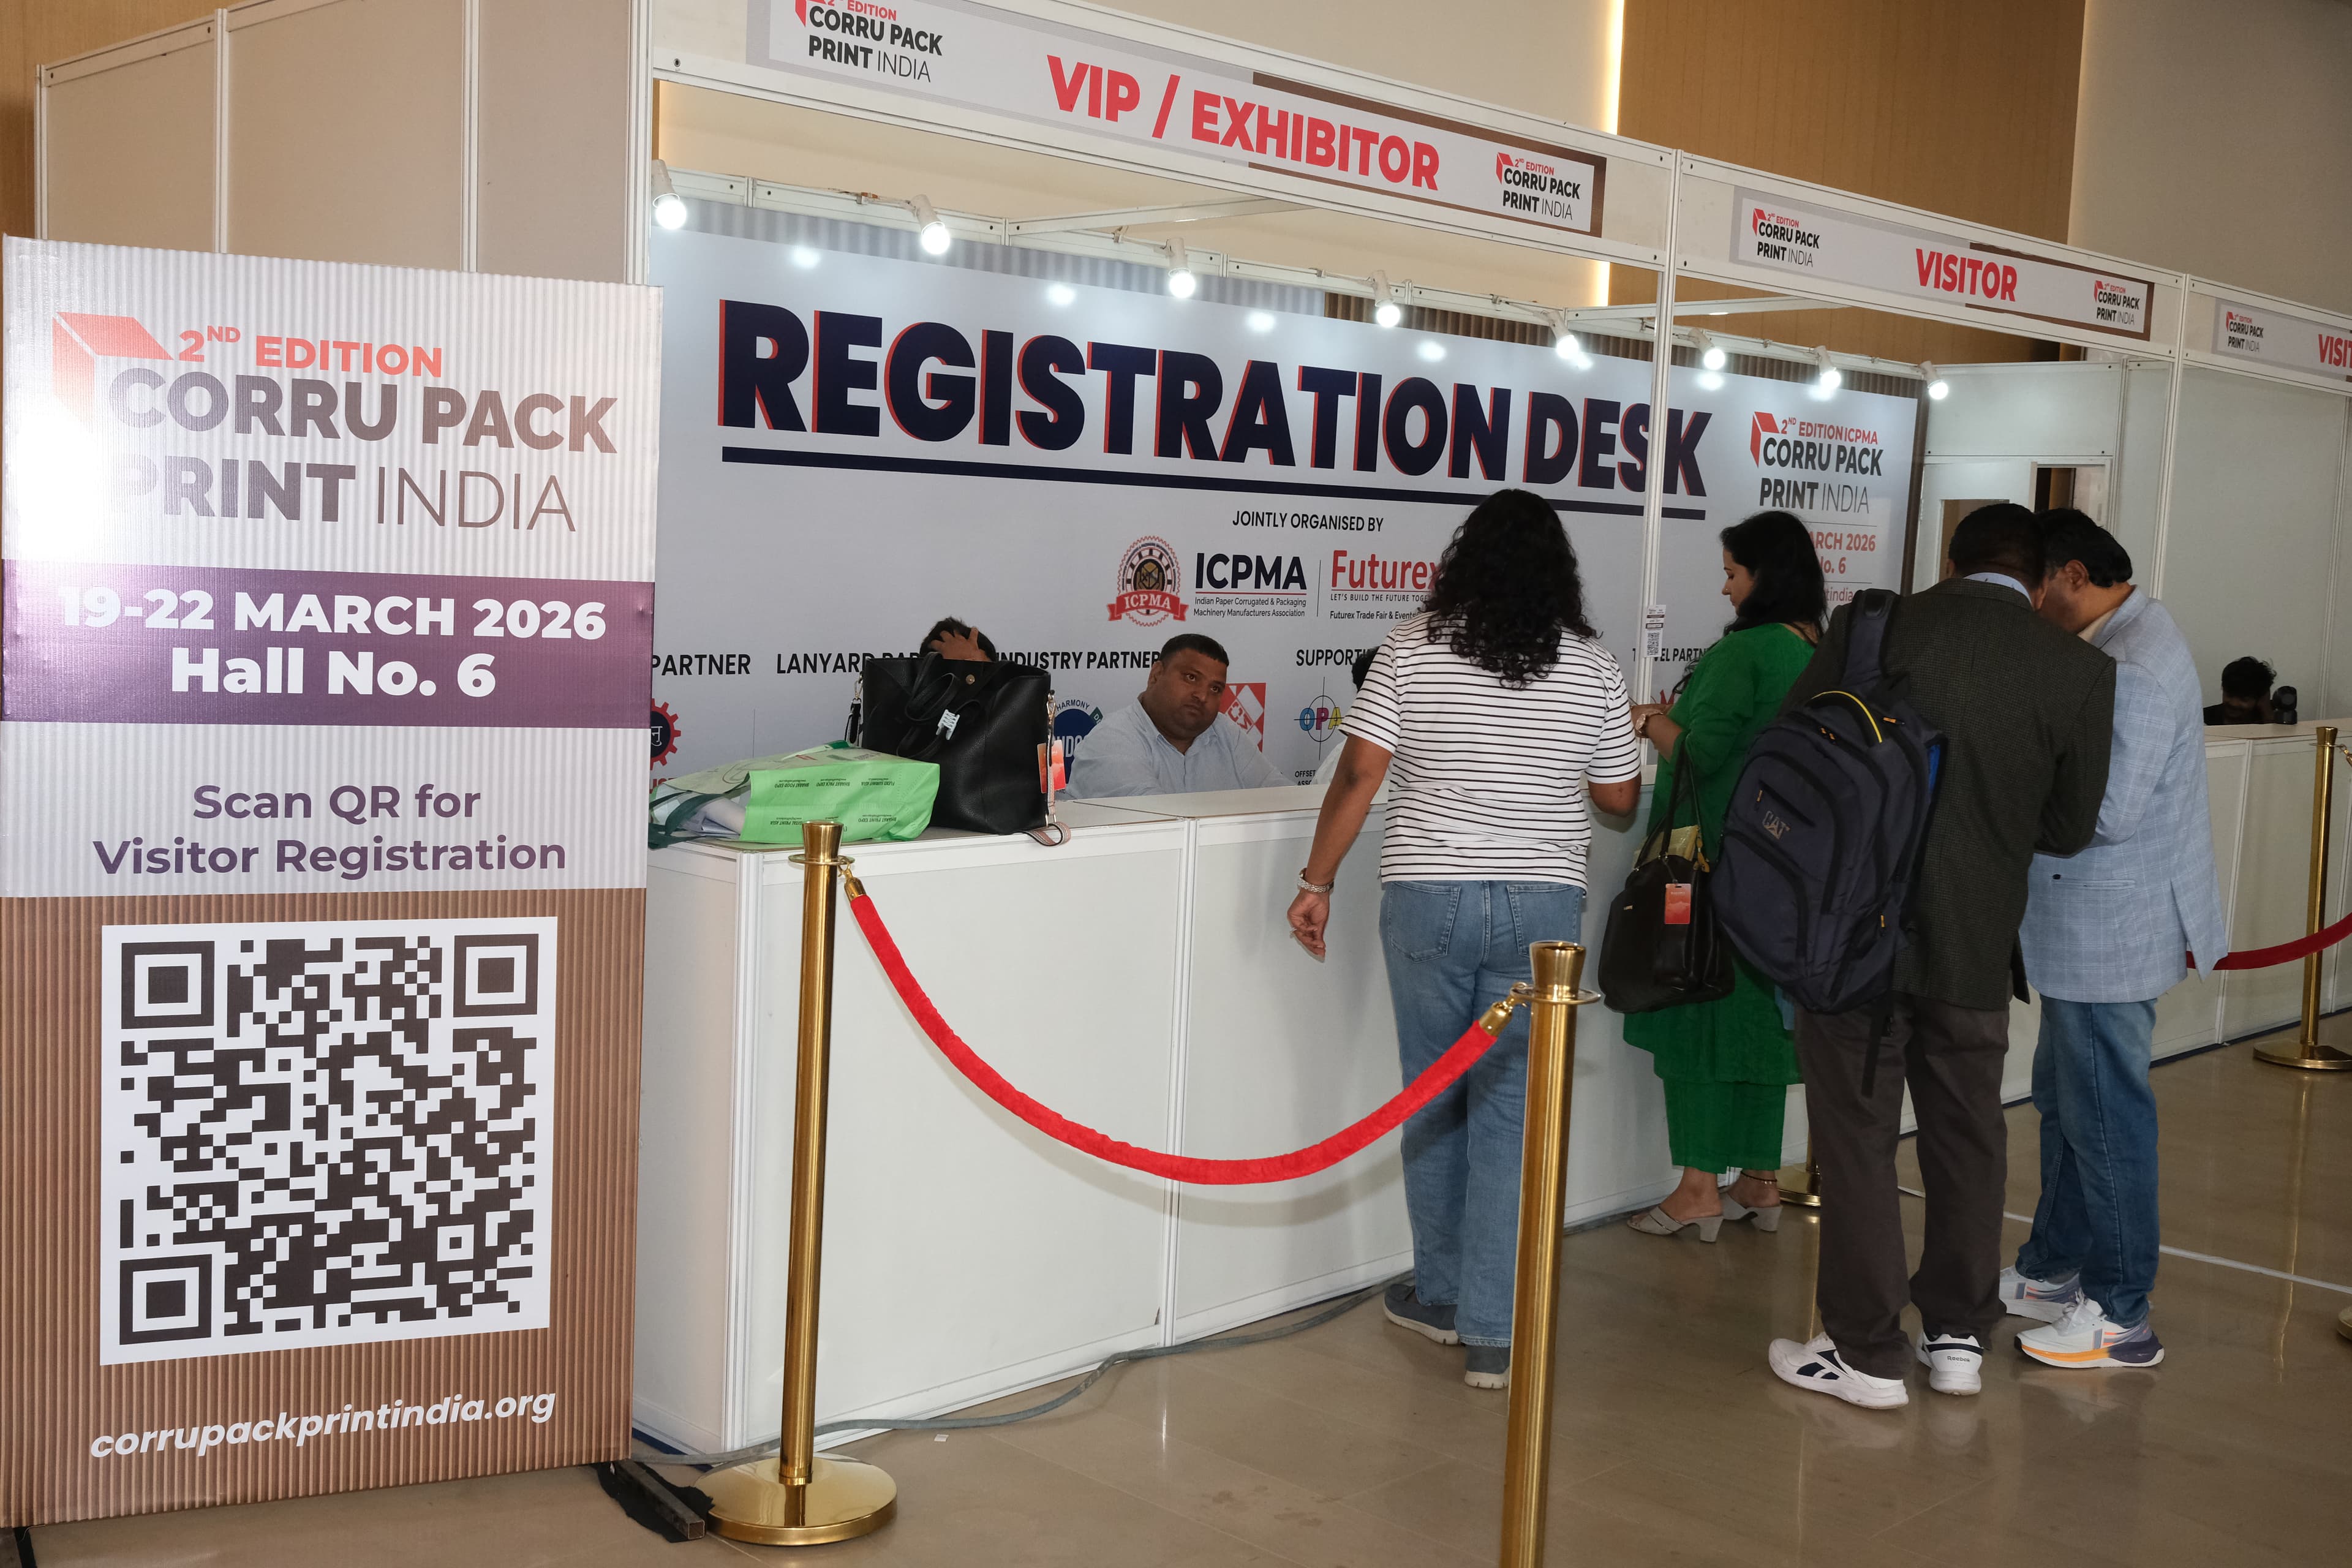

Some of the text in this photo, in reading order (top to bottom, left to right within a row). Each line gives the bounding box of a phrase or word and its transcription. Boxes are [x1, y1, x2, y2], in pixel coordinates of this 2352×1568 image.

[847, 0, 897, 21] EDITION
[809, 6, 943, 56] CORRU PACK
[809, 34, 931, 83] PRINT INDIA
[1047, 55, 1140, 122] VIP
[1191, 89, 1439, 190] EXHIBITOR
[1526, 162, 1555, 176] EDITION
[1504, 168, 1581, 200] CORRU PACK
[1503, 190, 1573, 221] PRINT INDIA
[1758, 222, 1820, 249] CORRU PACK
[1776, 216, 1800, 228] EDITION
[1757, 241, 1813, 268] PRINT INDIA
[1915, 247, 2018, 303] VISITOR
[2098, 291, 2140, 310] CORRU PACK
[2097, 307, 2135, 325] PRINT INDIA
[2228, 336, 2245, 350] PRINT
[2229, 321, 2264, 339] CORRU PACK
[179, 326, 442, 378] 2ND EDITION
[109, 368, 617, 454] CORRU PACK
[718, 299, 1713, 497] REGISTRATION DESK
[1781, 417, 1879, 445] 2ND EDITION ICPMA
[1763, 437, 1883, 477] CORRU PACK
[377, 466, 576, 532] INDIA
[1760, 478, 1869, 514] PRINT INDIA
[1232, 510, 1384, 532] JOINTLY ORGANISED BY
[1809, 530, 1876, 552] ARCH 2026
[1196, 552, 1307, 590] ICPMA
[1838, 557, 1847, 575] 6
[59, 586, 606, 640] 19-22 MARCH 2026
[1124, 594, 1171, 610] ICPMA
[1194, 608, 1226, 617] Machinery
[1227, 608, 1270, 617] Manufacturers
[1195, 597, 1214, 605] Indian
[1215, 597, 1234, 606] Paper
[1235, 597, 1268, 607] Corrugated
[1276, 598, 1306, 608] Packaging
[1330, 611, 1355, 619] Futurex
[1356, 611, 1374, 619] Trade
[1376, 611, 1387, 619] Fair
[652, 654, 751, 676] PARTNER
[1296, 649, 1366, 666] SUPPORT
[172, 647, 497, 698] Hall No. 6
[1056, 699, 1090, 712] HARMONY
[193, 783, 481, 825] Scan QR for
[93, 834, 567, 880] Visitor Registration
[90, 1391, 556, 1459] corrupackprintindia.org
